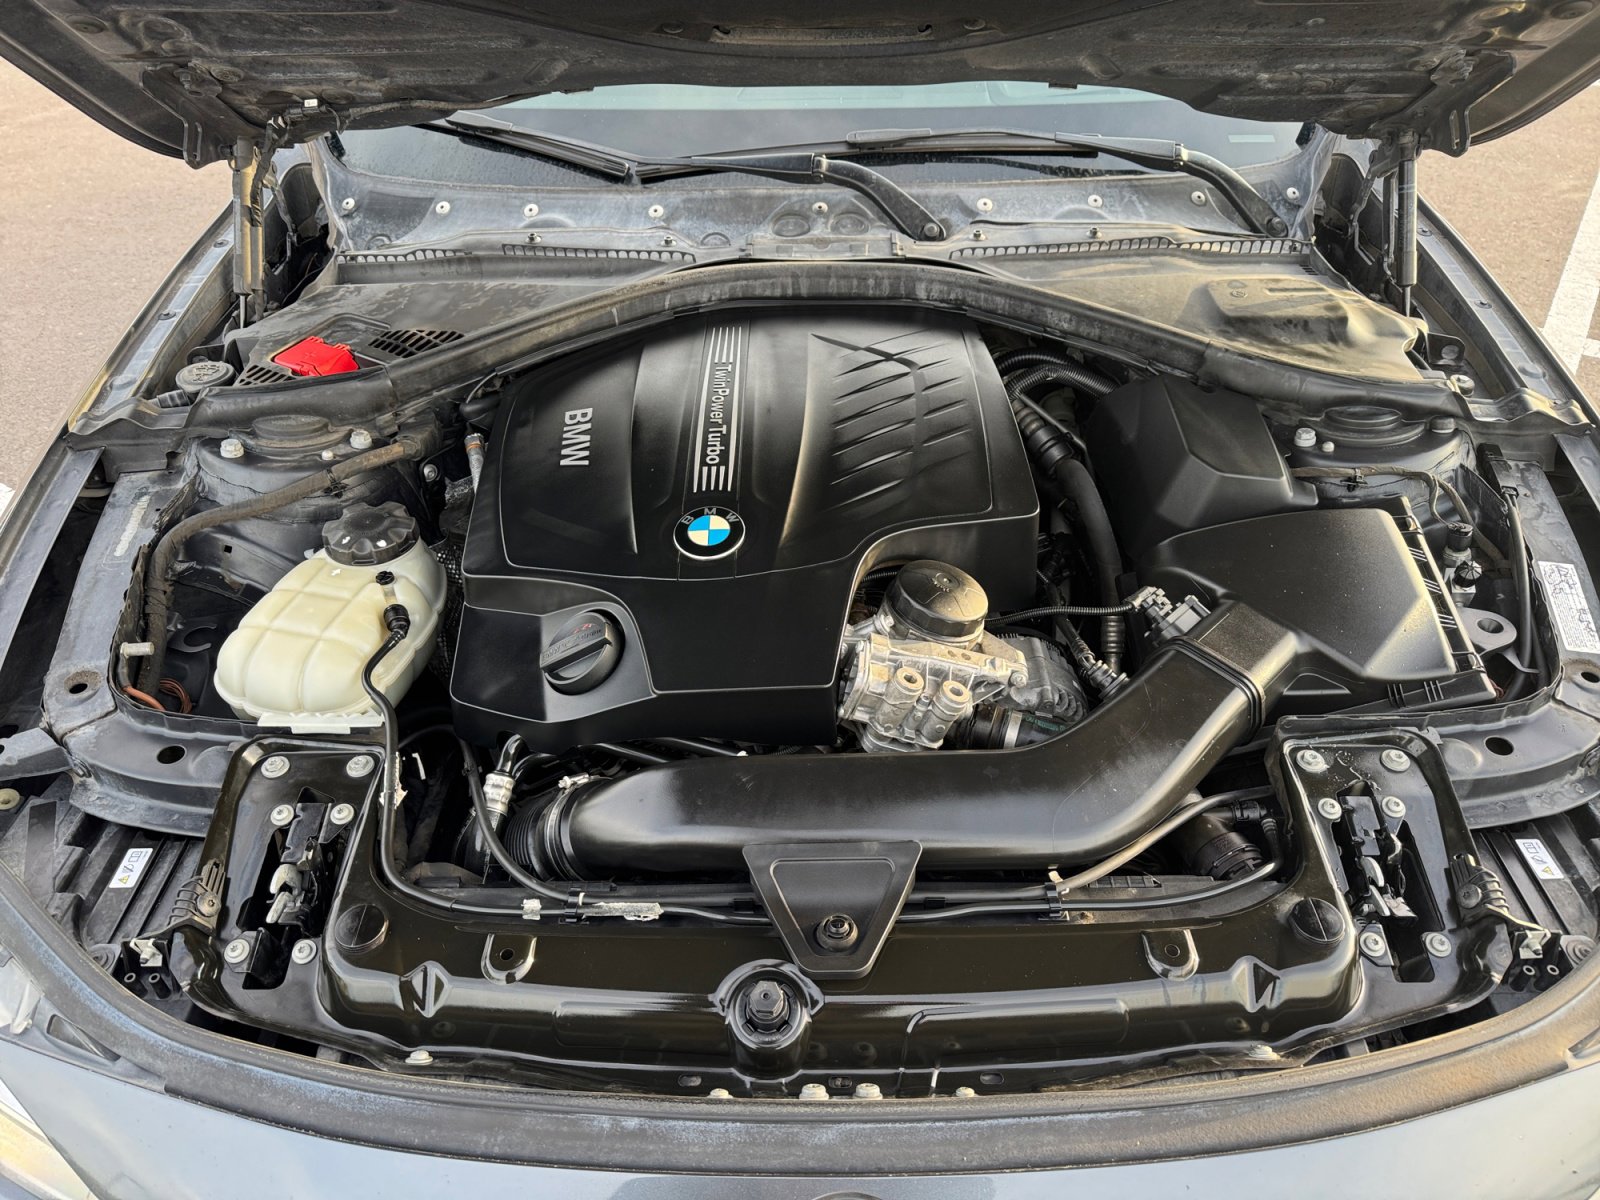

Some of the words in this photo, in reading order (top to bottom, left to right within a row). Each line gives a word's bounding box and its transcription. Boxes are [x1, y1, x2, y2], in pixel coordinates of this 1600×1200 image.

[710, 364, 732, 424] TwinPower
[559, 407, 593, 466] BMW
[705, 424, 727, 465] Turbo
[681, 507, 740, 525] BMW
